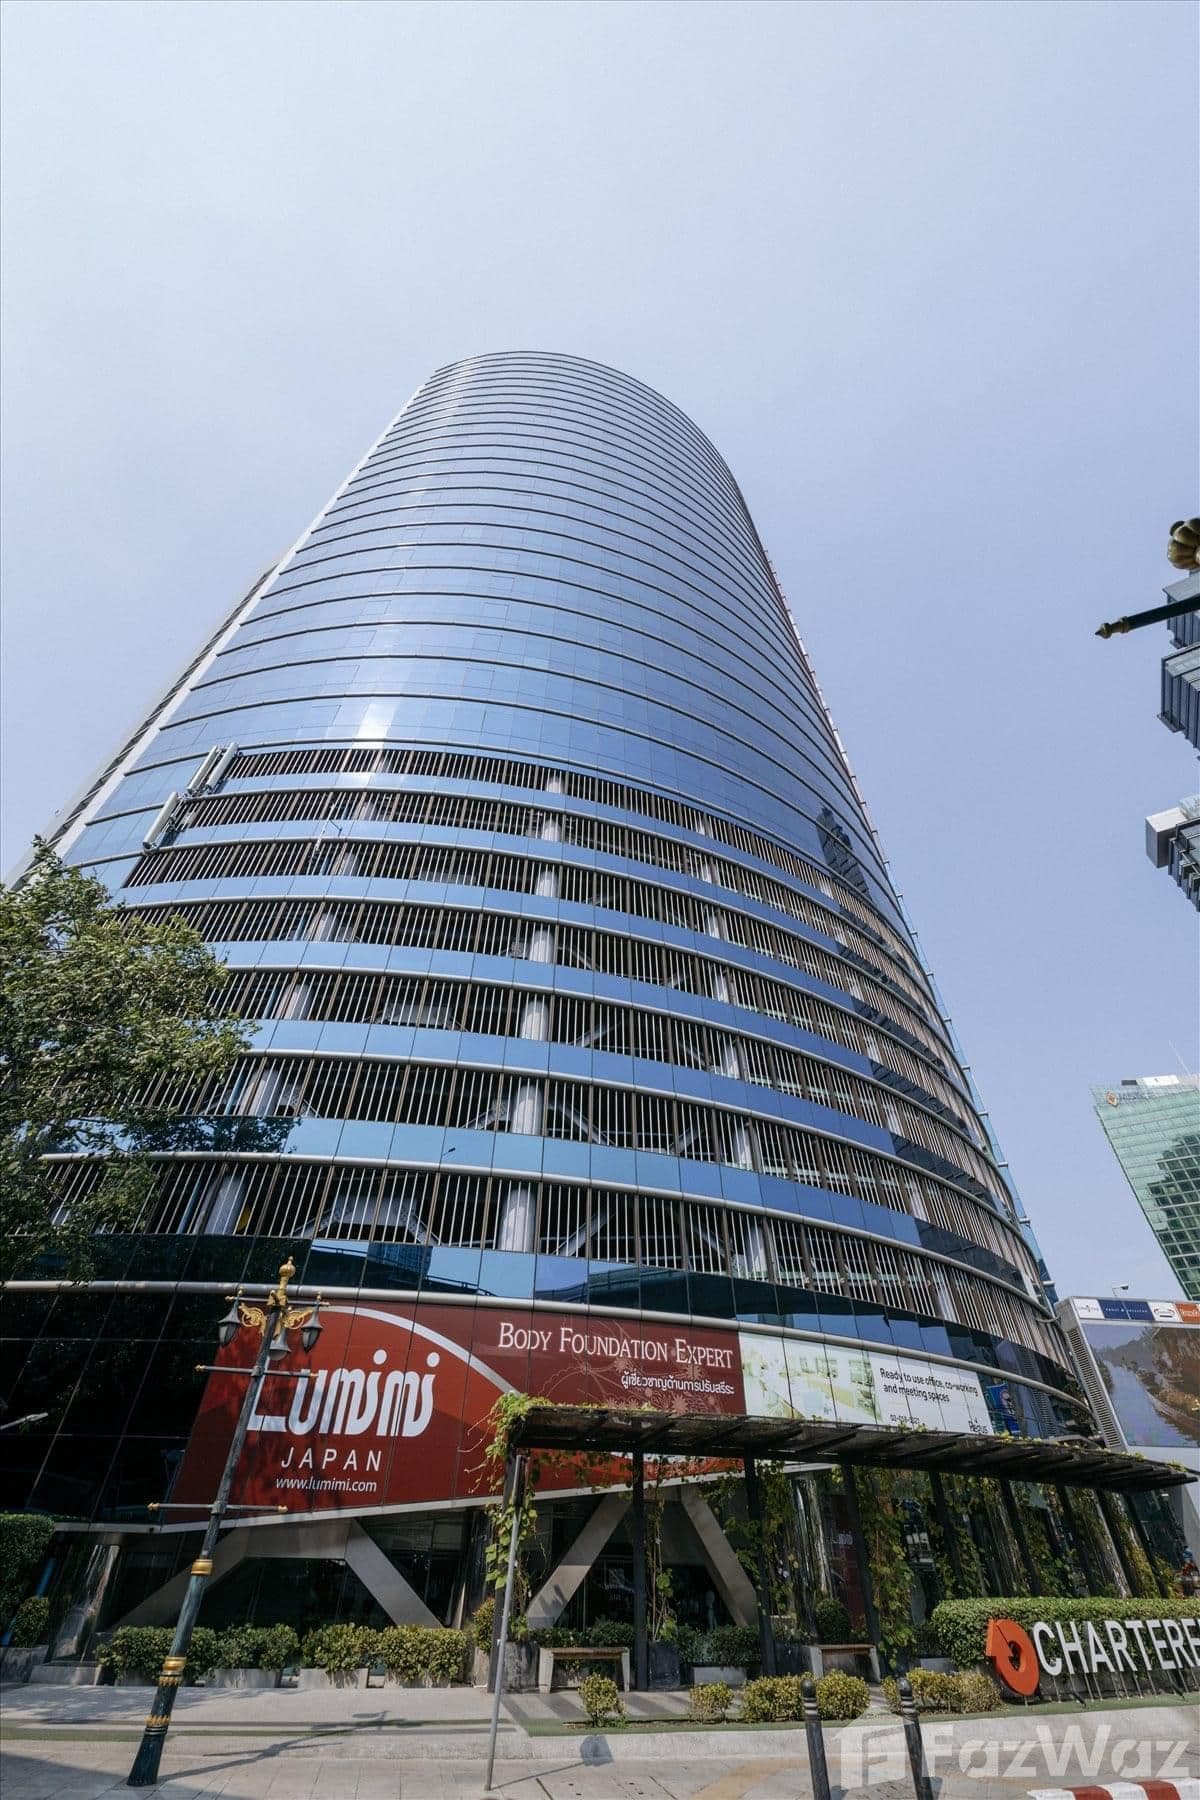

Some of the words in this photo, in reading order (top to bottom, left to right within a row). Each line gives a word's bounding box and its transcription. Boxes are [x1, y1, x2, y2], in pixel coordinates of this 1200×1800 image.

[880, 1367, 903, 1383] Ready
[904, 1373, 911, 1381] to
[912, 1377, 924, 1385] use
[945, 1382, 978, 1396] co-working
[883, 1384, 897, 1394] and
[898, 1387, 928, 1401] meeting
[928, 1391, 950, 1402] spaces
[280, 1447, 382, 1471] JAPAN
[276, 1475, 377, 1493] www.lumimi.com
[1033, 1618, 1200, 1676] CHARTERE
